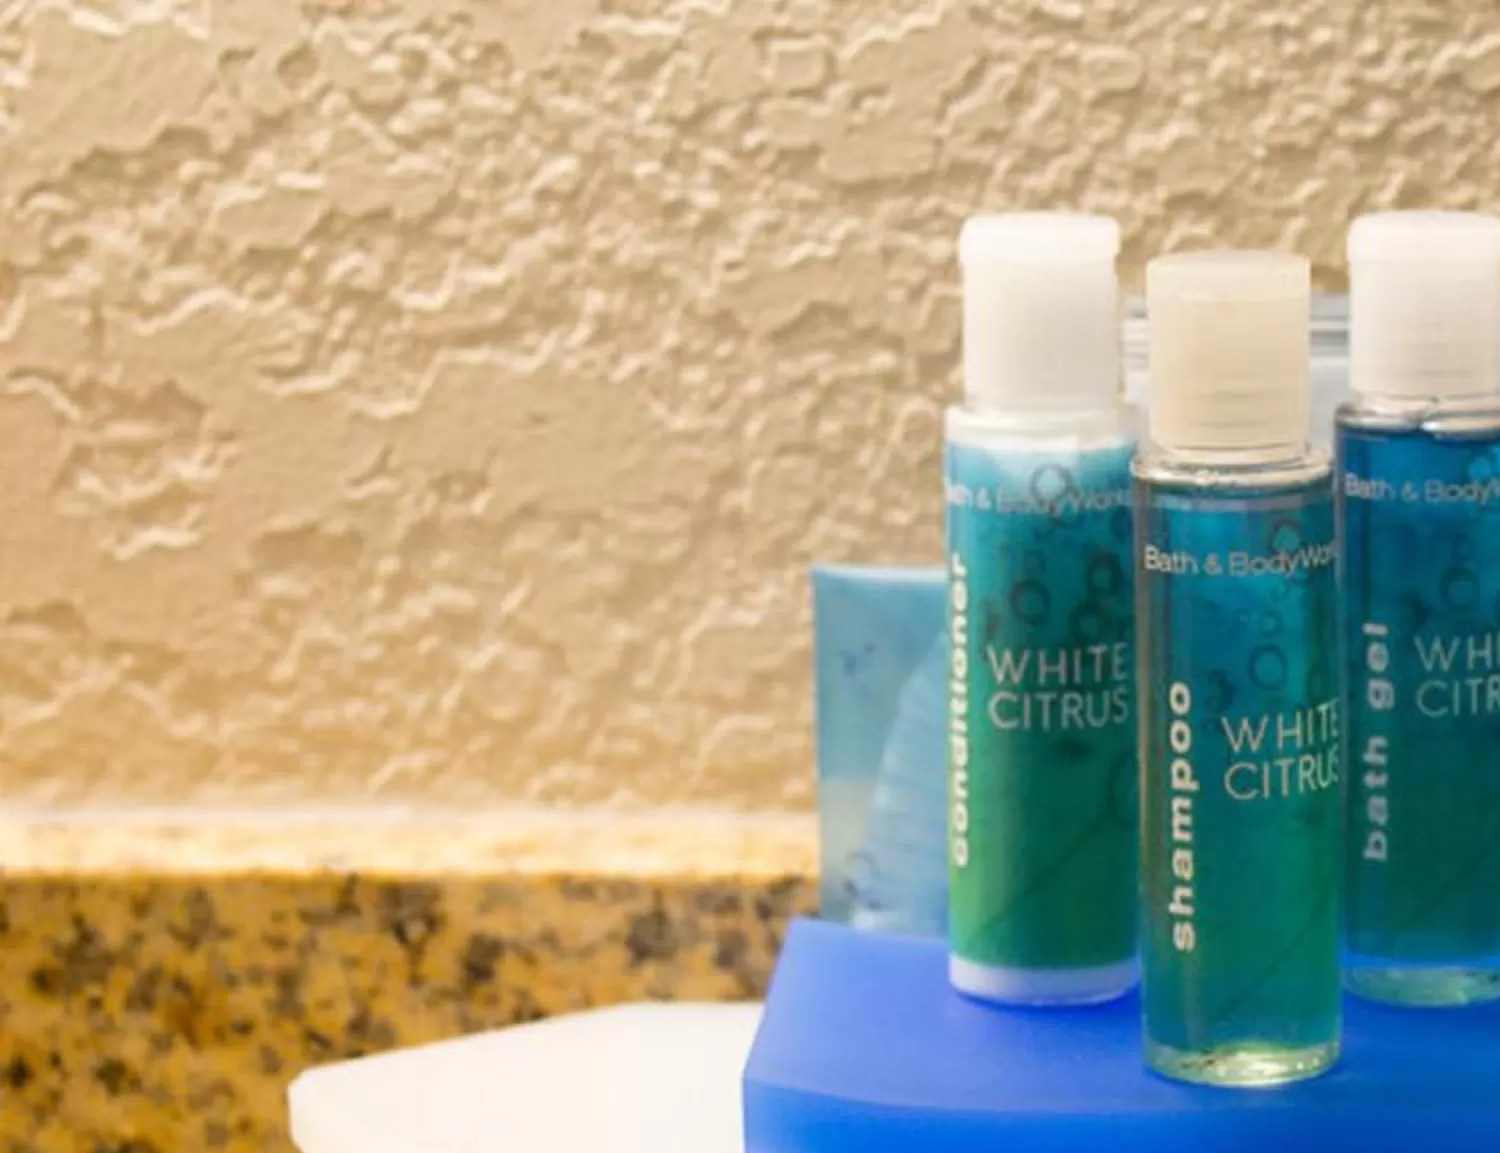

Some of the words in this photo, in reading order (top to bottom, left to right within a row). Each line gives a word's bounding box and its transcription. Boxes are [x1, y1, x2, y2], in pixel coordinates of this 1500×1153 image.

[1144, 543, 1199, 575] Bath
[1203, 552, 1224, 576] &
[987, 641, 1129, 686] WHITE
[1362, 622, 1395, 710] gel
[987, 685, 1129, 731] CITRUS
[1168, 681, 1200, 952] shampoo
[1362, 735, 1389, 862] bath
